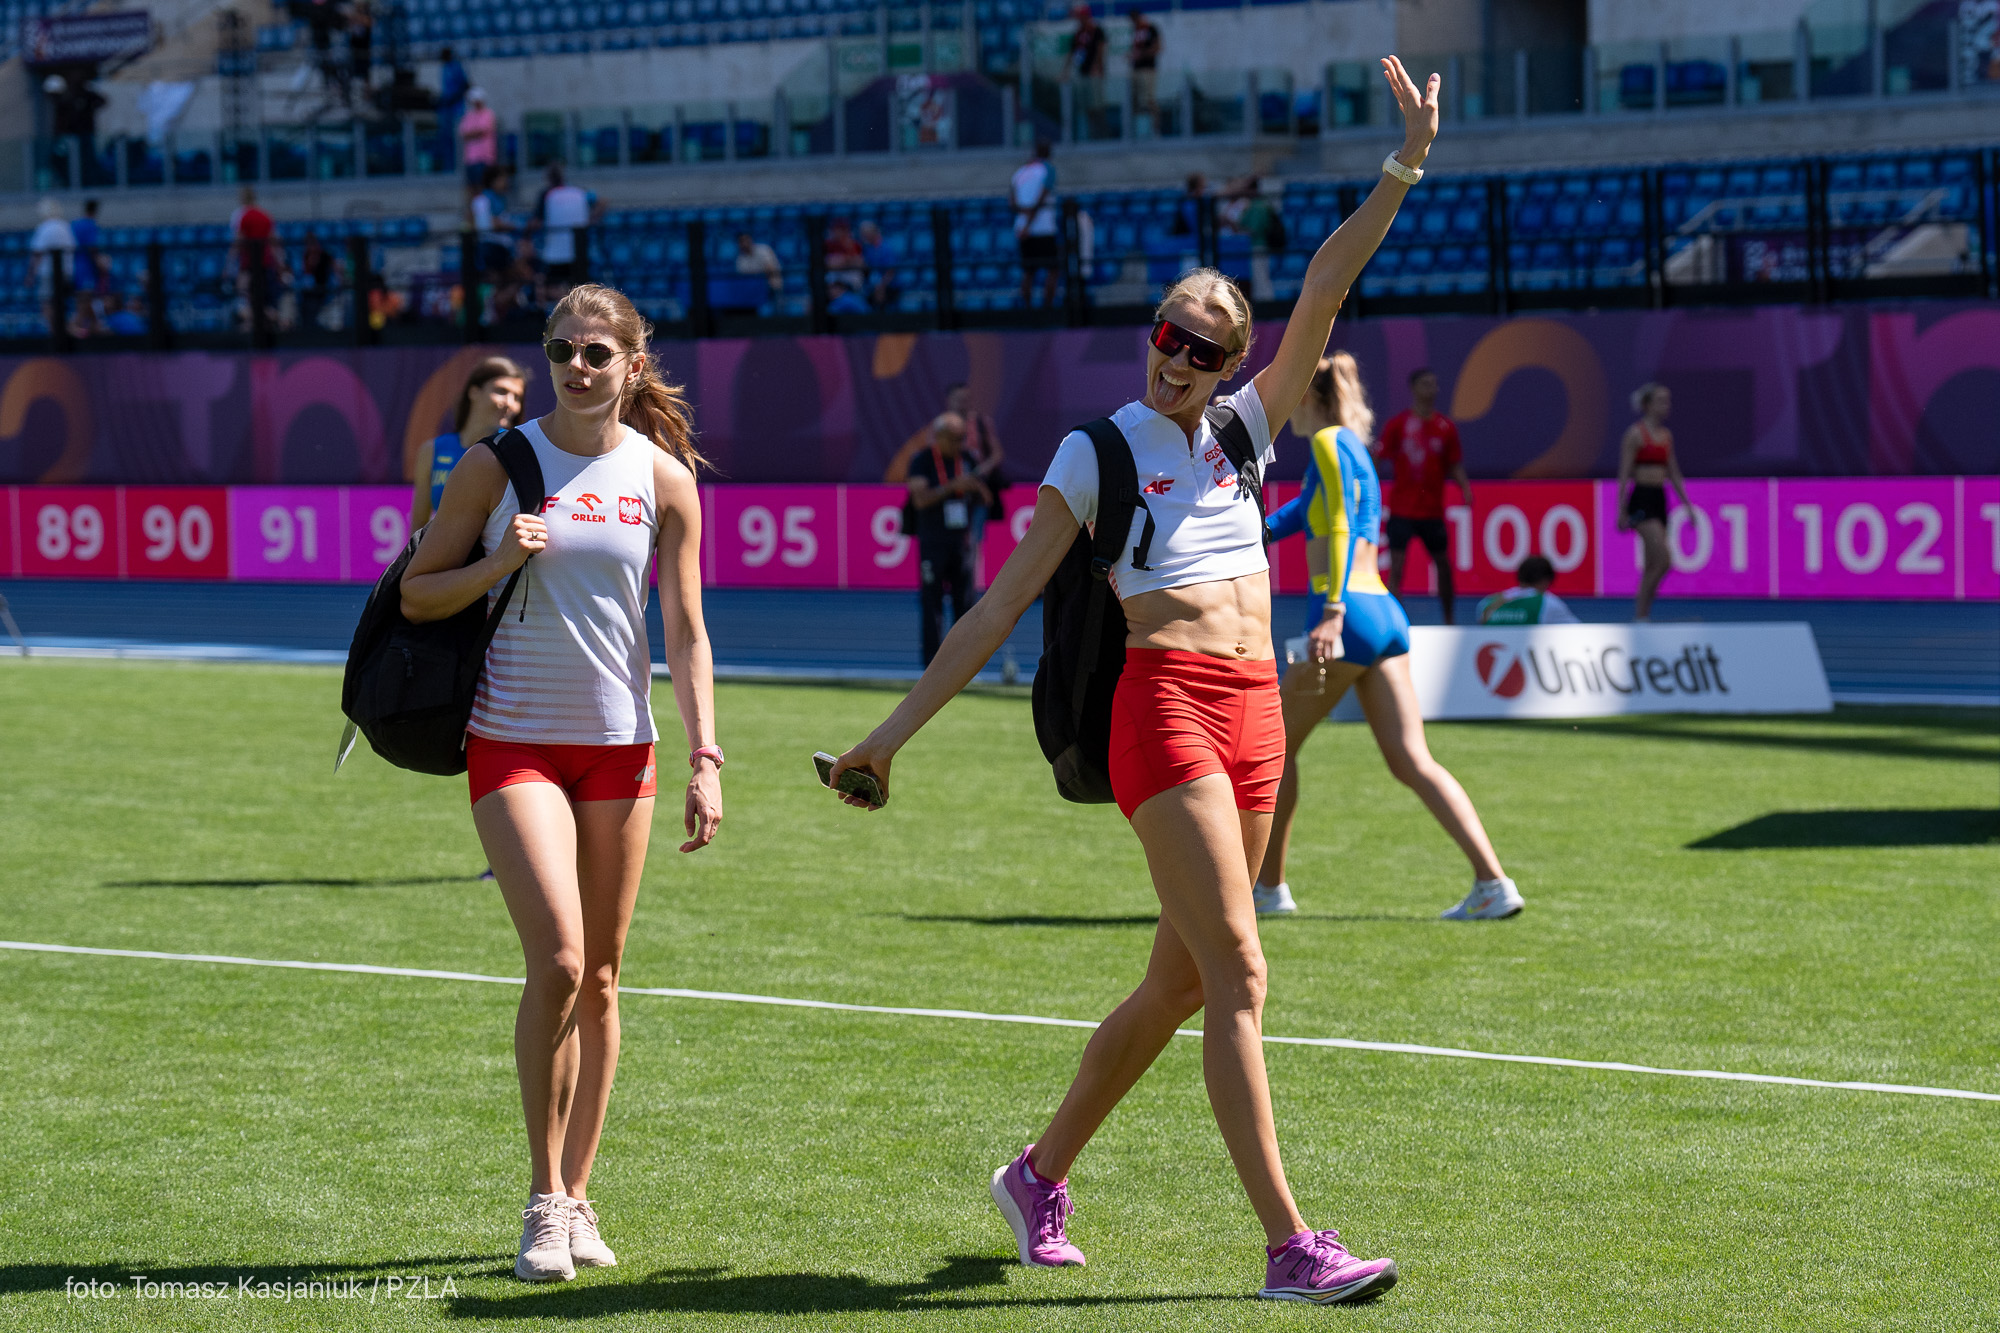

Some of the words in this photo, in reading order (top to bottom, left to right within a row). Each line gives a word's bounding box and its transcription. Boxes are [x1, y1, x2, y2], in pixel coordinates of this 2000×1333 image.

[36, 504, 105, 561] 89
[142, 504, 213, 562] 90
[260, 505, 318, 564] 91
[370, 505, 411, 564] 9
[571, 513, 606, 523] ORLEN
[738, 505, 819, 568] 95
[870, 505, 911, 569] 9
[1445, 503, 1588, 573] 100
[1634, 502, 1748, 574] 01
[1793, 501, 1945, 575] 102
[1527, 643, 1731, 695] UniCredit
